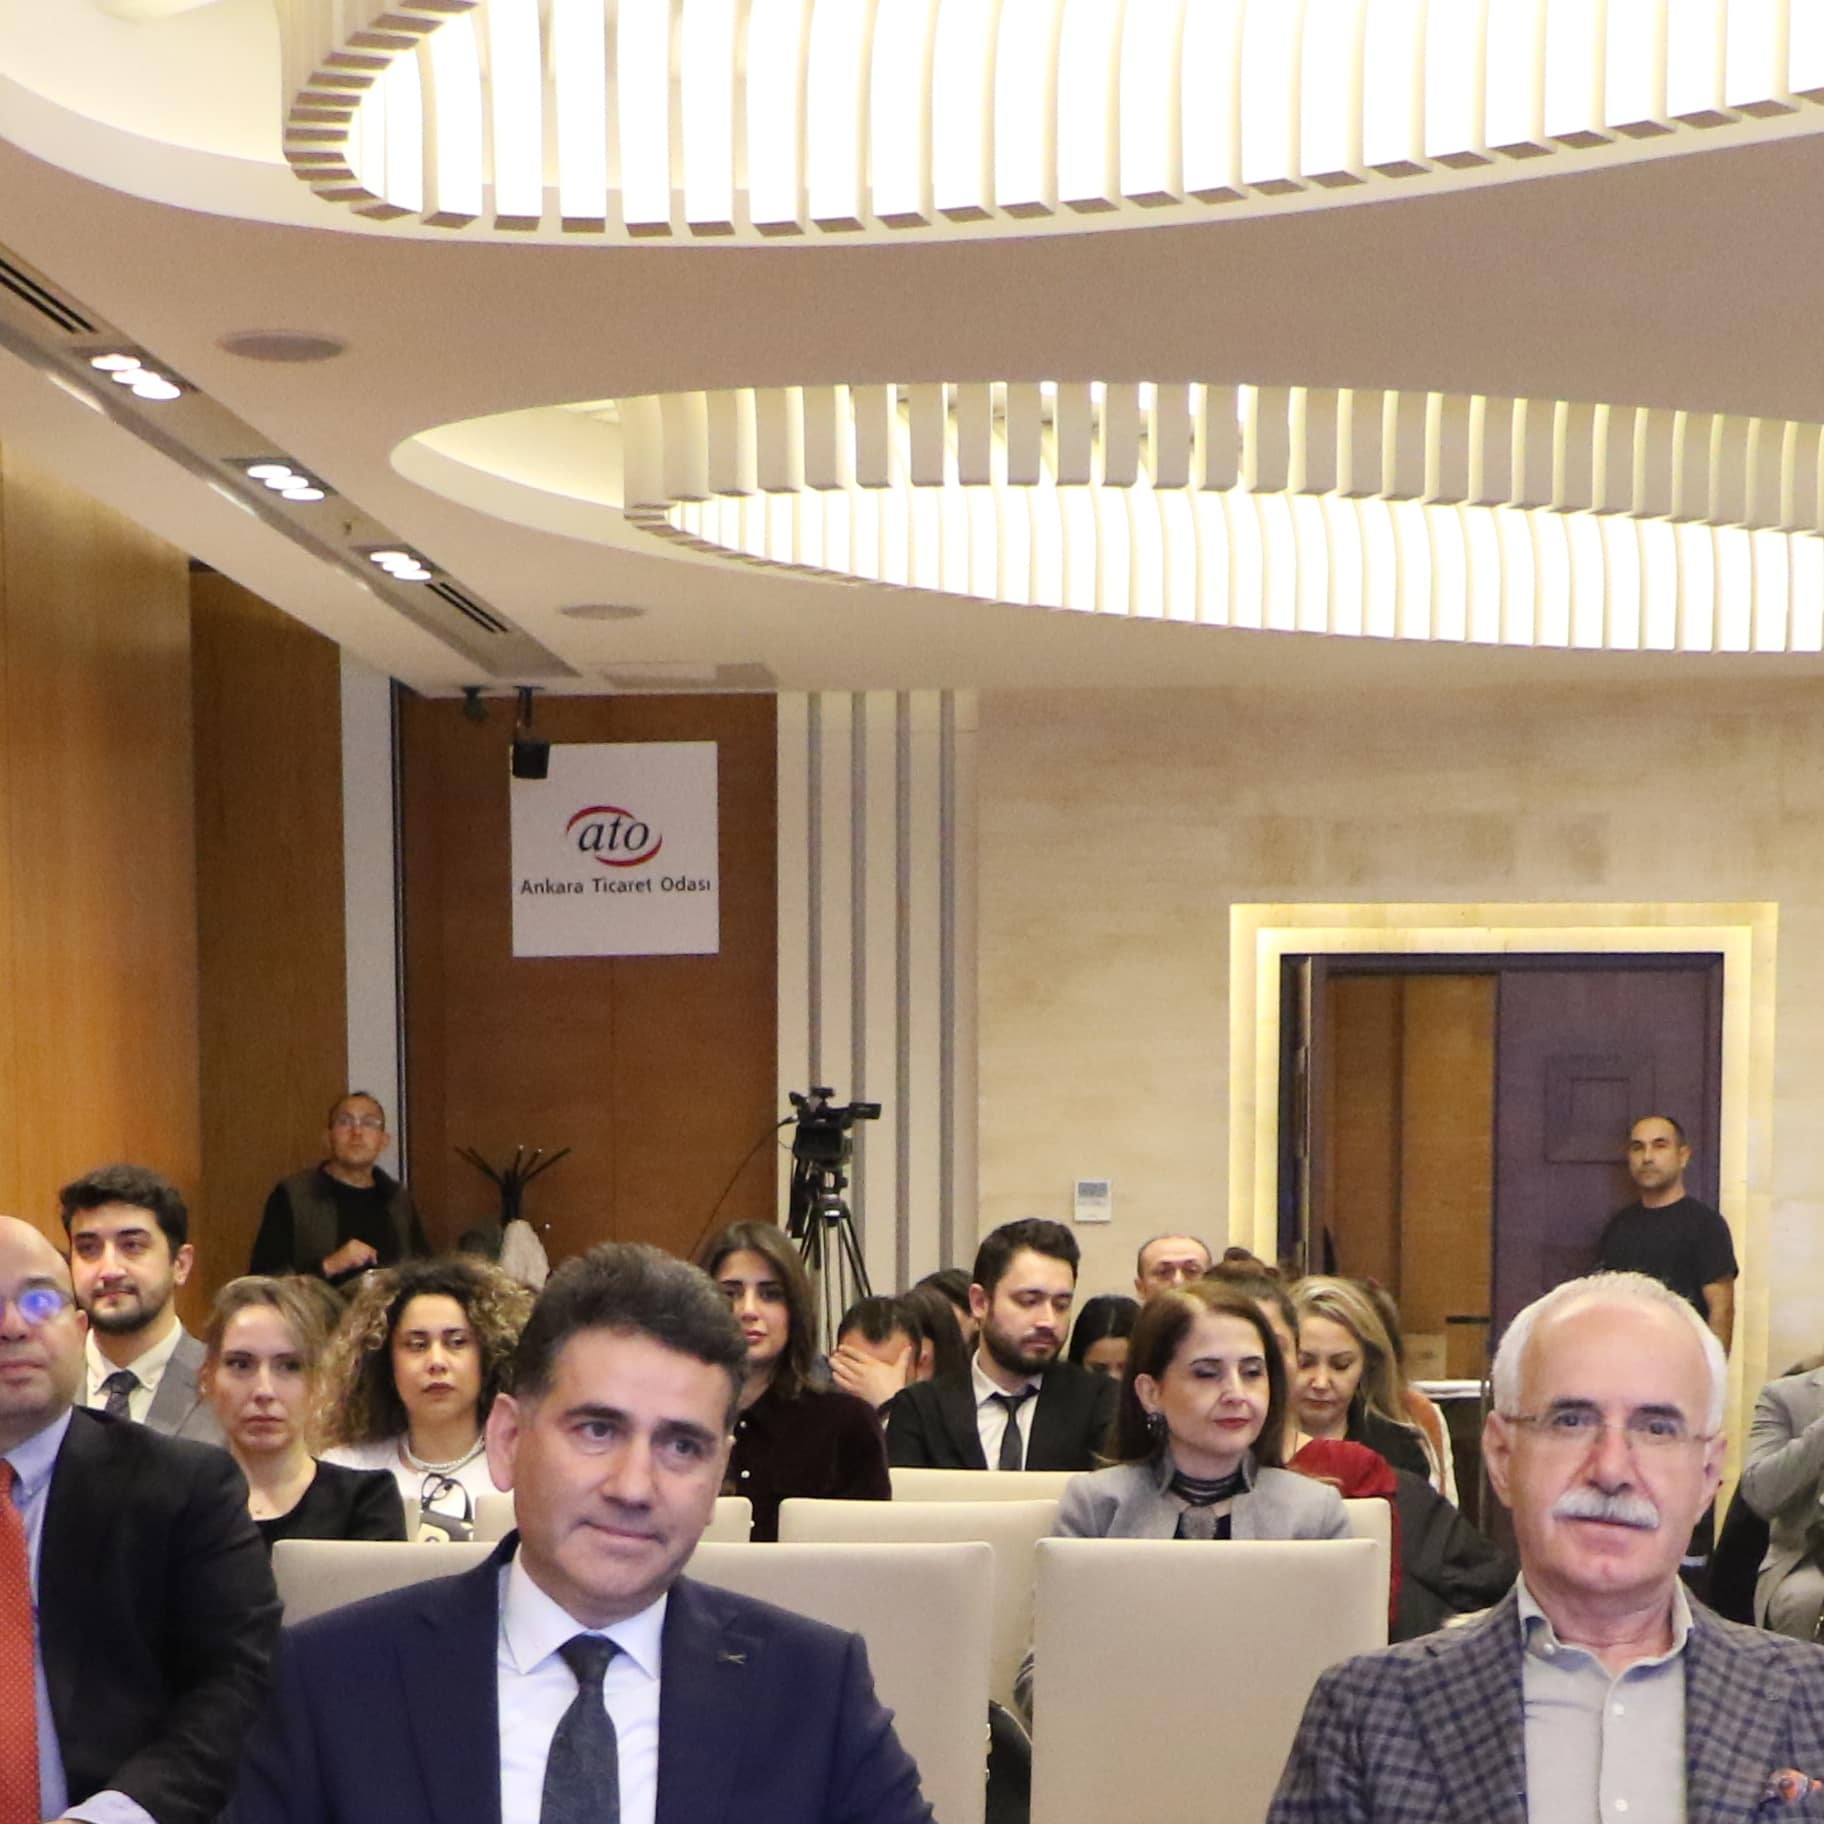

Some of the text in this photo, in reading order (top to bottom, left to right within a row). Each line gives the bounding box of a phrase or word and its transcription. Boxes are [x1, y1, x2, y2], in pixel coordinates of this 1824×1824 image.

[578, 815, 650, 852] ato
[520, 875, 711, 895] Ankara Ticaret Odası
